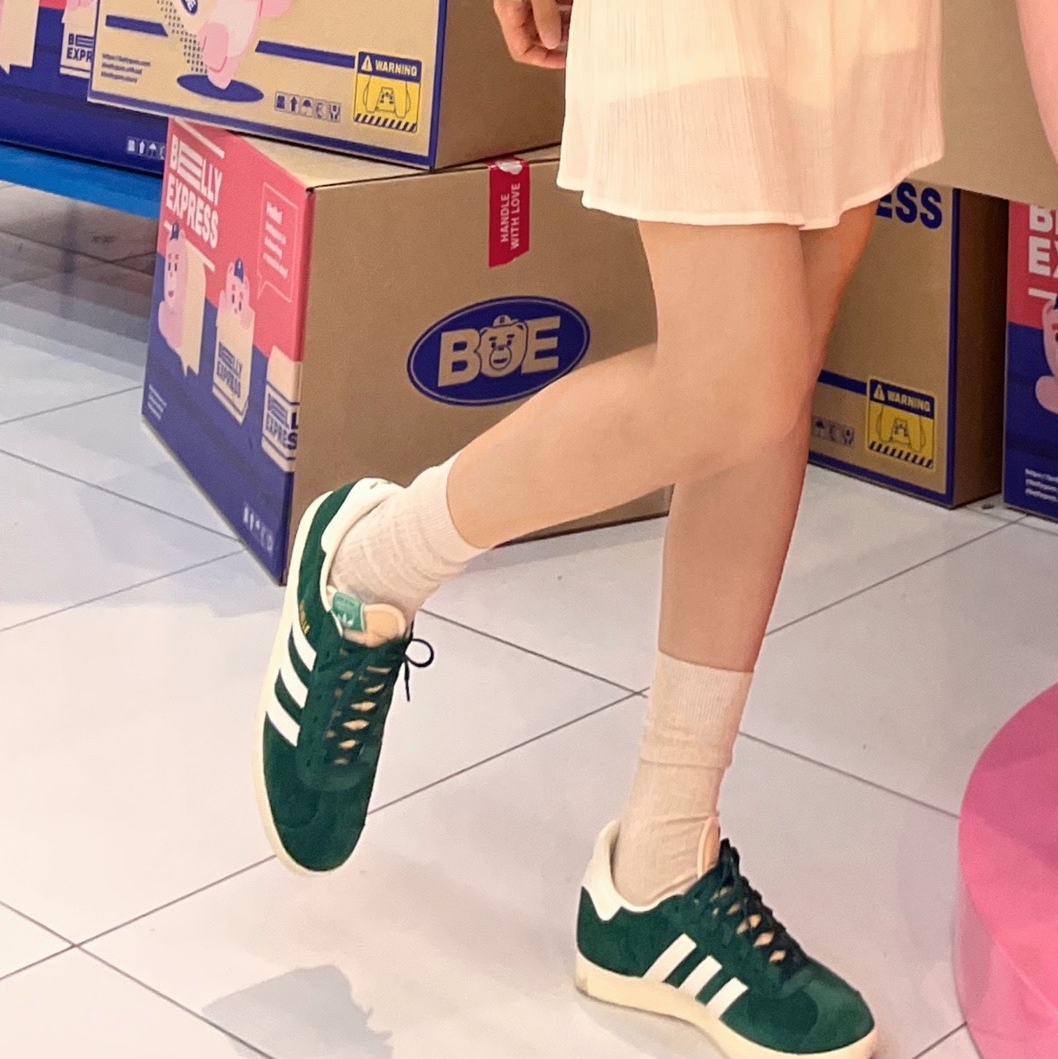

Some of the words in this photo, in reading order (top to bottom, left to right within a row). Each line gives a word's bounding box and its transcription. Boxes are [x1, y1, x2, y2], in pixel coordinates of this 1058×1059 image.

[375, 59, 418, 77] WARNING
[170, 134, 223, 206] BELLY
[166, 172, 219, 249] EXPRESS
[510, 182, 521, 214] LOVE
[500, 193, 510, 243] HANDLE
[510, 216, 520, 250] WITH
[887, 390, 931, 412] WARNING
